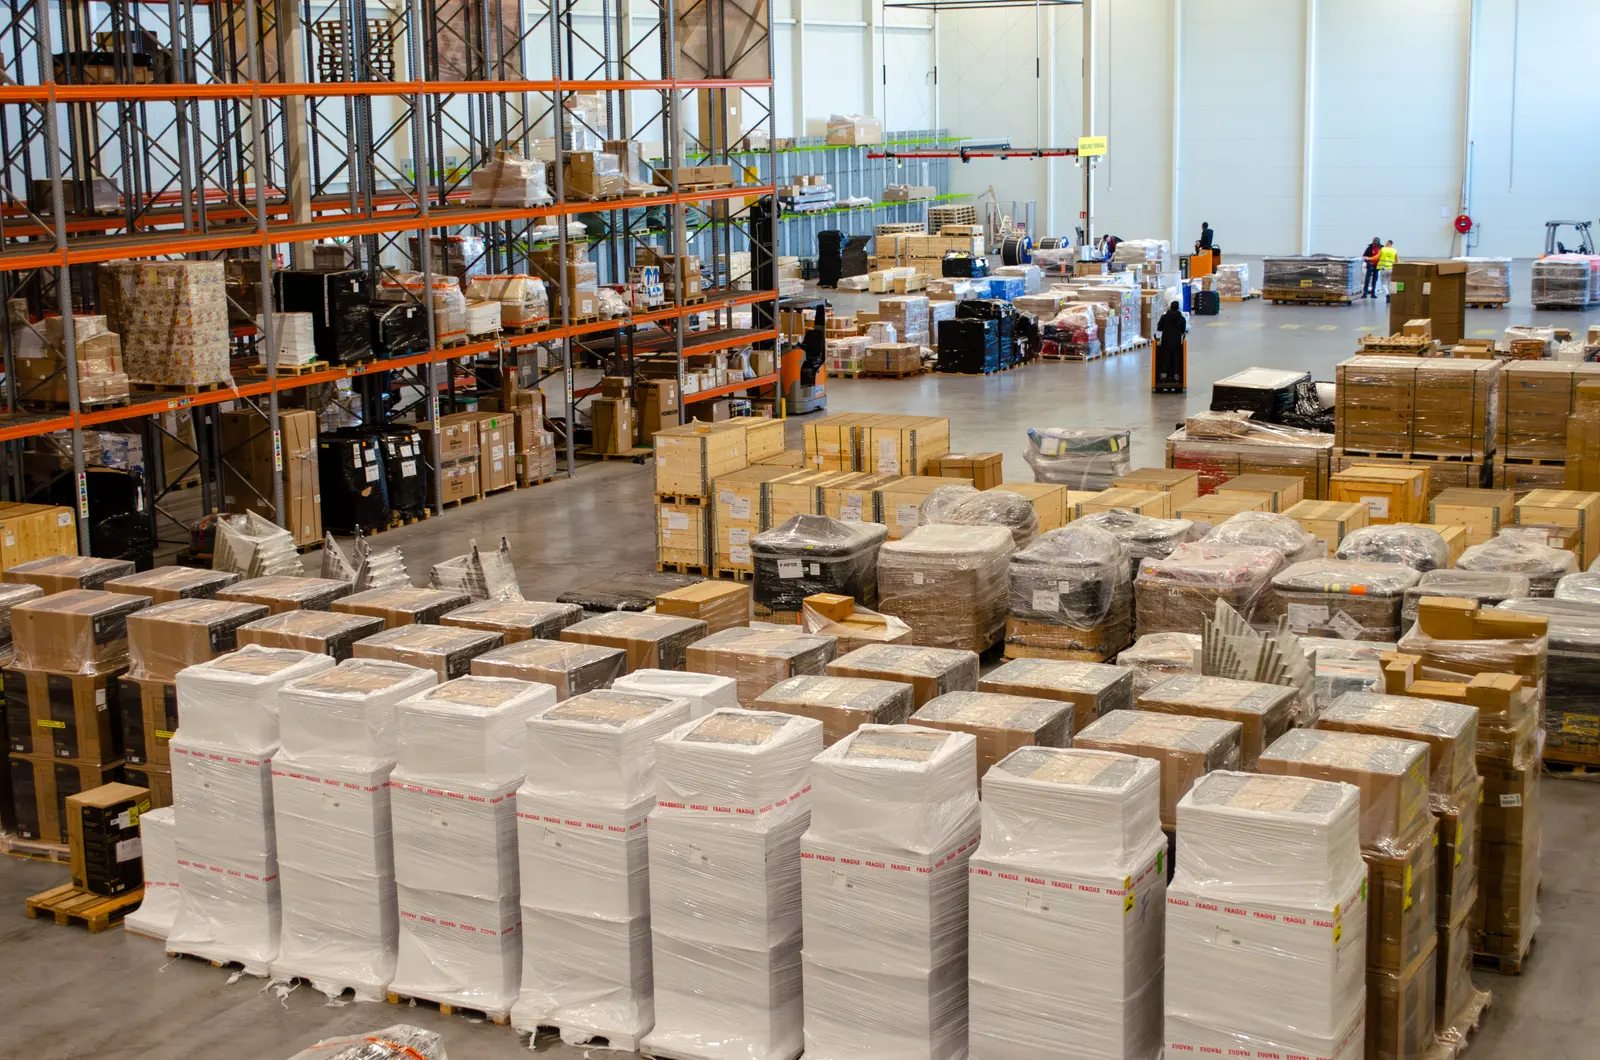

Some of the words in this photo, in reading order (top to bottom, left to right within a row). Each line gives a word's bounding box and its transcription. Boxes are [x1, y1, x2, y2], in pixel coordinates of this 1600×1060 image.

[816, 854, 835, 862] FRAGILE
[998, 873, 1019, 881] FRAGILE
[1024, 877, 1045, 885] FRAGILE
[1051, 881, 1072, 889] FRAGILE
[1168, 898, 1189, 907] FRAGILE
[1196, 902, 1218, 912] FRAGILE
[1224, 907, 1246, 916] FRAGILE
[1253, 911, 1276, 920] FRAGILE
[1283, 916, 1306, 925] FRAGILE
[1200, 1046, 1222, 1054] FRAGILE
[1257, 1051, 1279, 1059] FRAGILE
